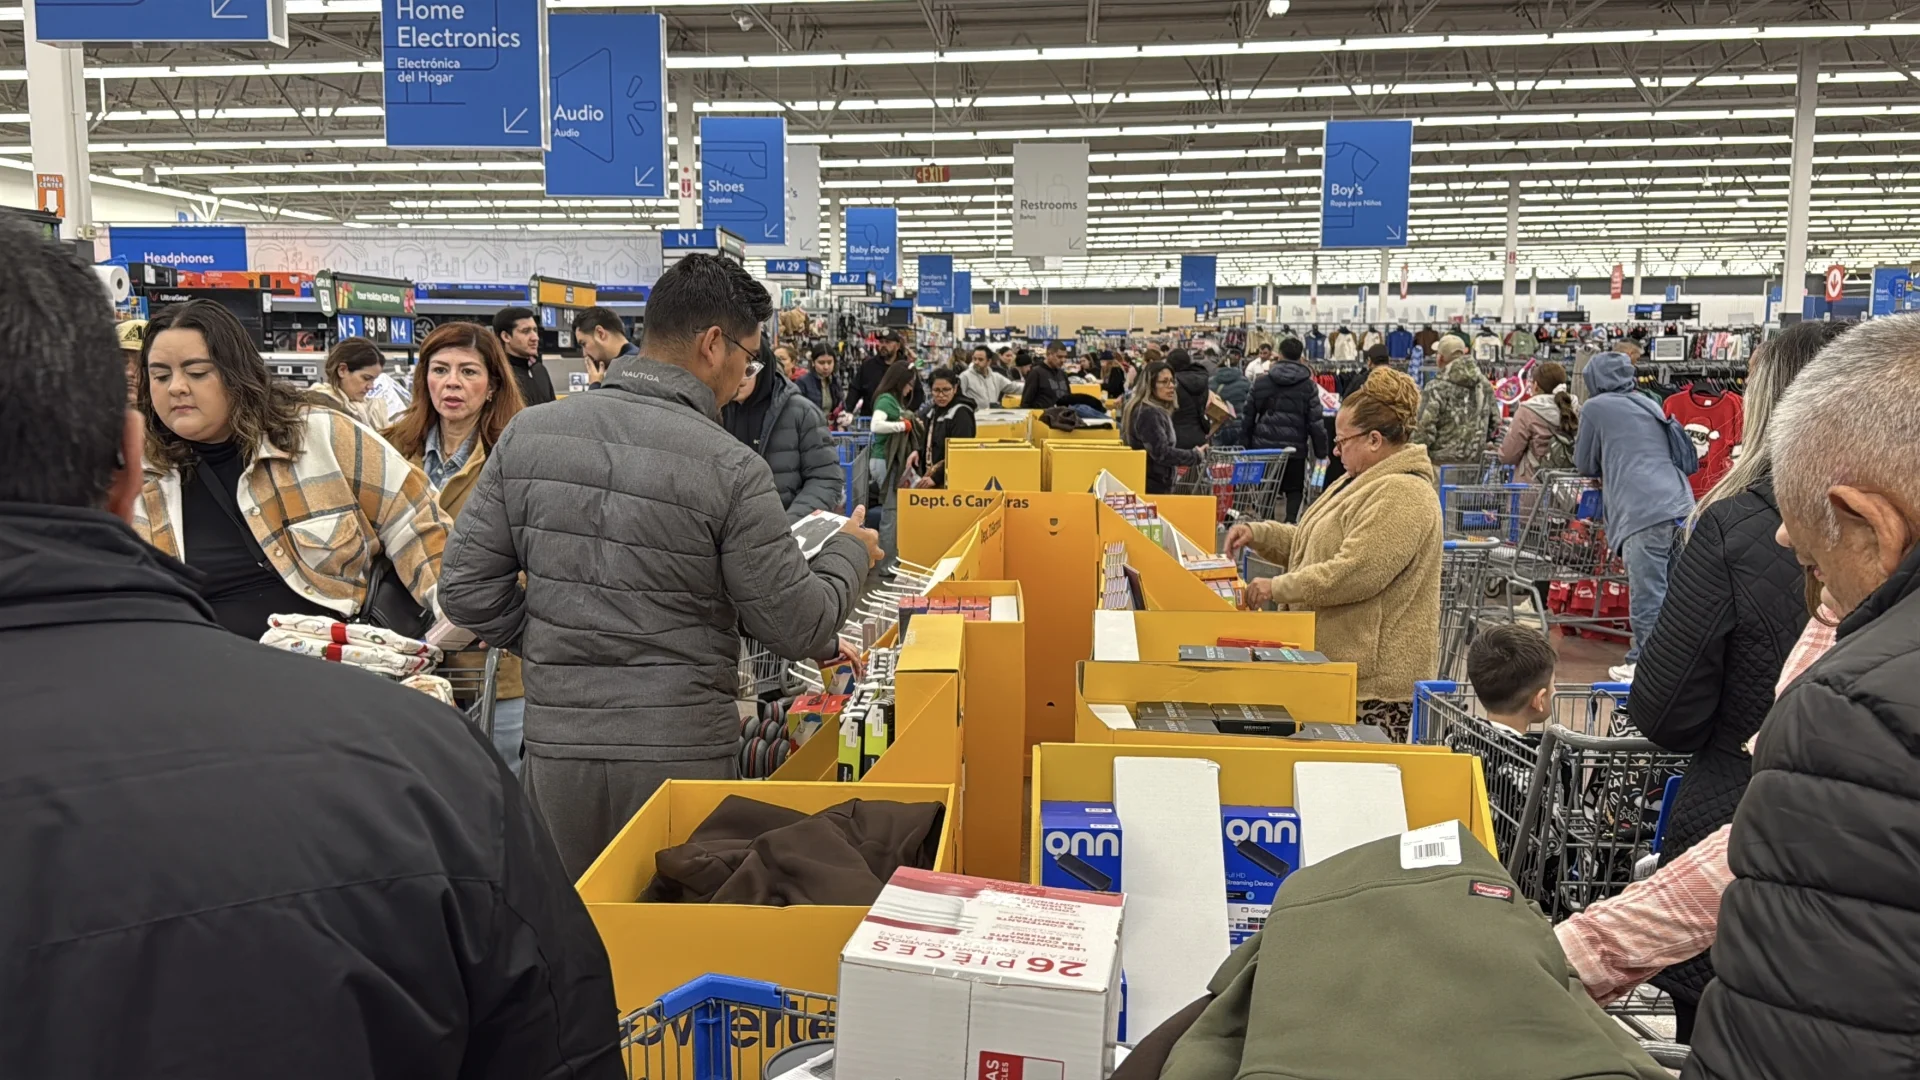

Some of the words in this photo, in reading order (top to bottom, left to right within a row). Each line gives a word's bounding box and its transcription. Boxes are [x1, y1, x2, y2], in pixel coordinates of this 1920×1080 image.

[397, 0, 465, 20] Home
[397, 26, 521, 48] Electronics
[397, 57, 460, 69] Electrónica
[398, 71, 414, 82] del
[419, 71, 454, 85] Hogar
[553, 104, 604, 121] Audio
[554, 128, 580, 138] Audio
[922, 166, 944, 182] EXIT
[708, 180, 745, 192] Shoes
[1331, 183, 1364, 199] Boy's
[708, 196, 733, 205] Zapatos
[1020, 199, 1078, 210] Restrooms
[1330, 200, 1347, 208] Ropa
[1363, 199, 1382, 207] Niños
[678, 233, 689, 245] N
[691, 233, 697, 245] 1
[850, 246, 869, 255] Baby
[871, 246, 890, 254] Food
[144, 252, 215, 266] Headphones
[776, 262, 786, 271] M
[787, 262, 800, 271] 29
[160, 292, 190, 301] UltraGear
[356, 291, 367, 300] Your
[367, 292, 382, 303] Holiday
[382, 293, 390, 302] Gift
[390, 294, 401, 304] Shop
[338, 317, 346, 338] N
[349, 318, 356, 337] 5
[391, 320, 398, 339] N
[400, 320, 406, 339] 4
[621, 370, 660, 383] NAUTICA
[909, 493, 949, 508] Dept.
[953, 494, 962, 507] 6
[966, 494, 1029, 508] Camras
[1225, 819, 1297, 844] onn
[1045, 831, 1119, 857] onn
[1227, 879, 1254, 887] Streaming
[871, 940, 1017, 971] PIÈCES
[1026, 957, 1087, 977] 26
